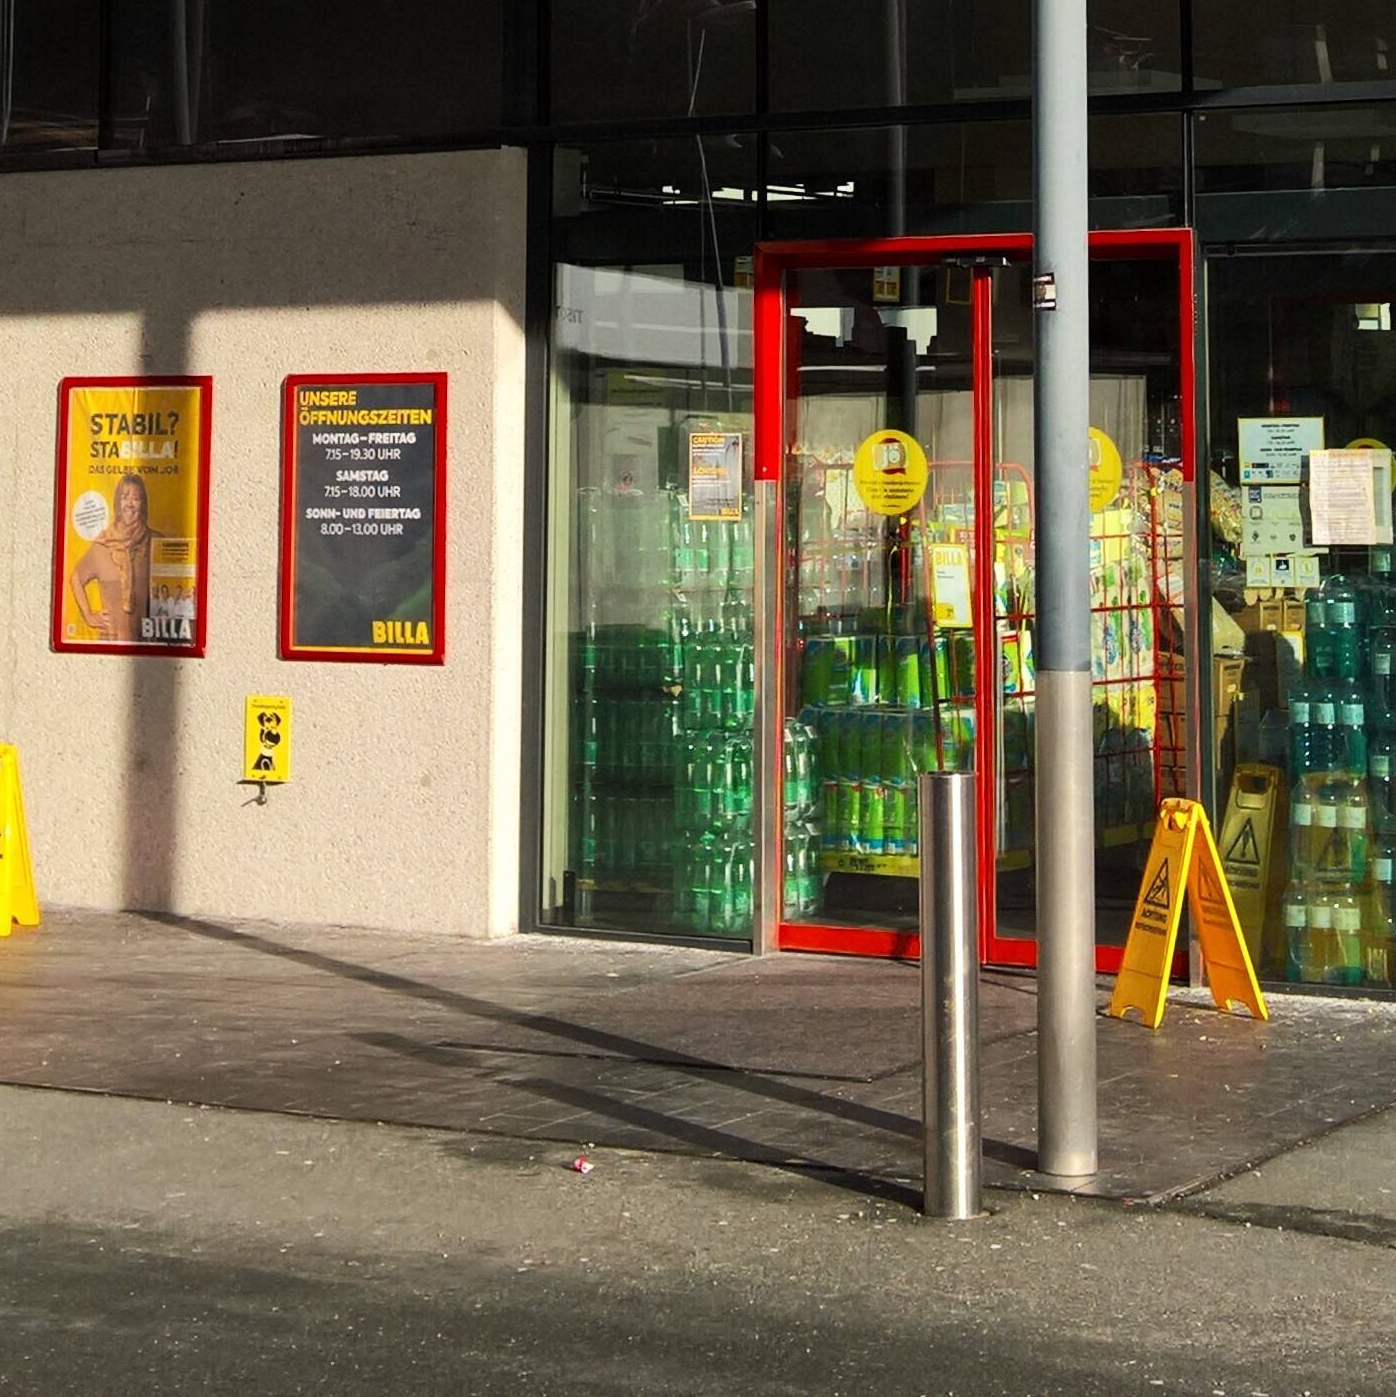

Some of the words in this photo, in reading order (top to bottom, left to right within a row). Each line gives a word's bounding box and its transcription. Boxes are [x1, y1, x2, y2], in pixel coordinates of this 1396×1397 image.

[299, 391, 357, 407] UNSERE
[90, 411, 180, 435] STABIL?
[299, 407, 432, 426] ÖFFNUNGSZEITEN
[90, 441, 179, 458] STABILLA!
[377, 448, 401, 459] UHR
[335, 470, 389, 482] SAMSTAG
[377, 486, 401, 497] UHR
[305, 508, 342, 519] SONN-
[342, 508, 367, 519] UND
[367, 508, 421, 519] FEIERTAG
[380, 523, 404, 535] UHR
[141, 617, 192, 640] BILLA
[372, 620, 429, 645] BILLA
